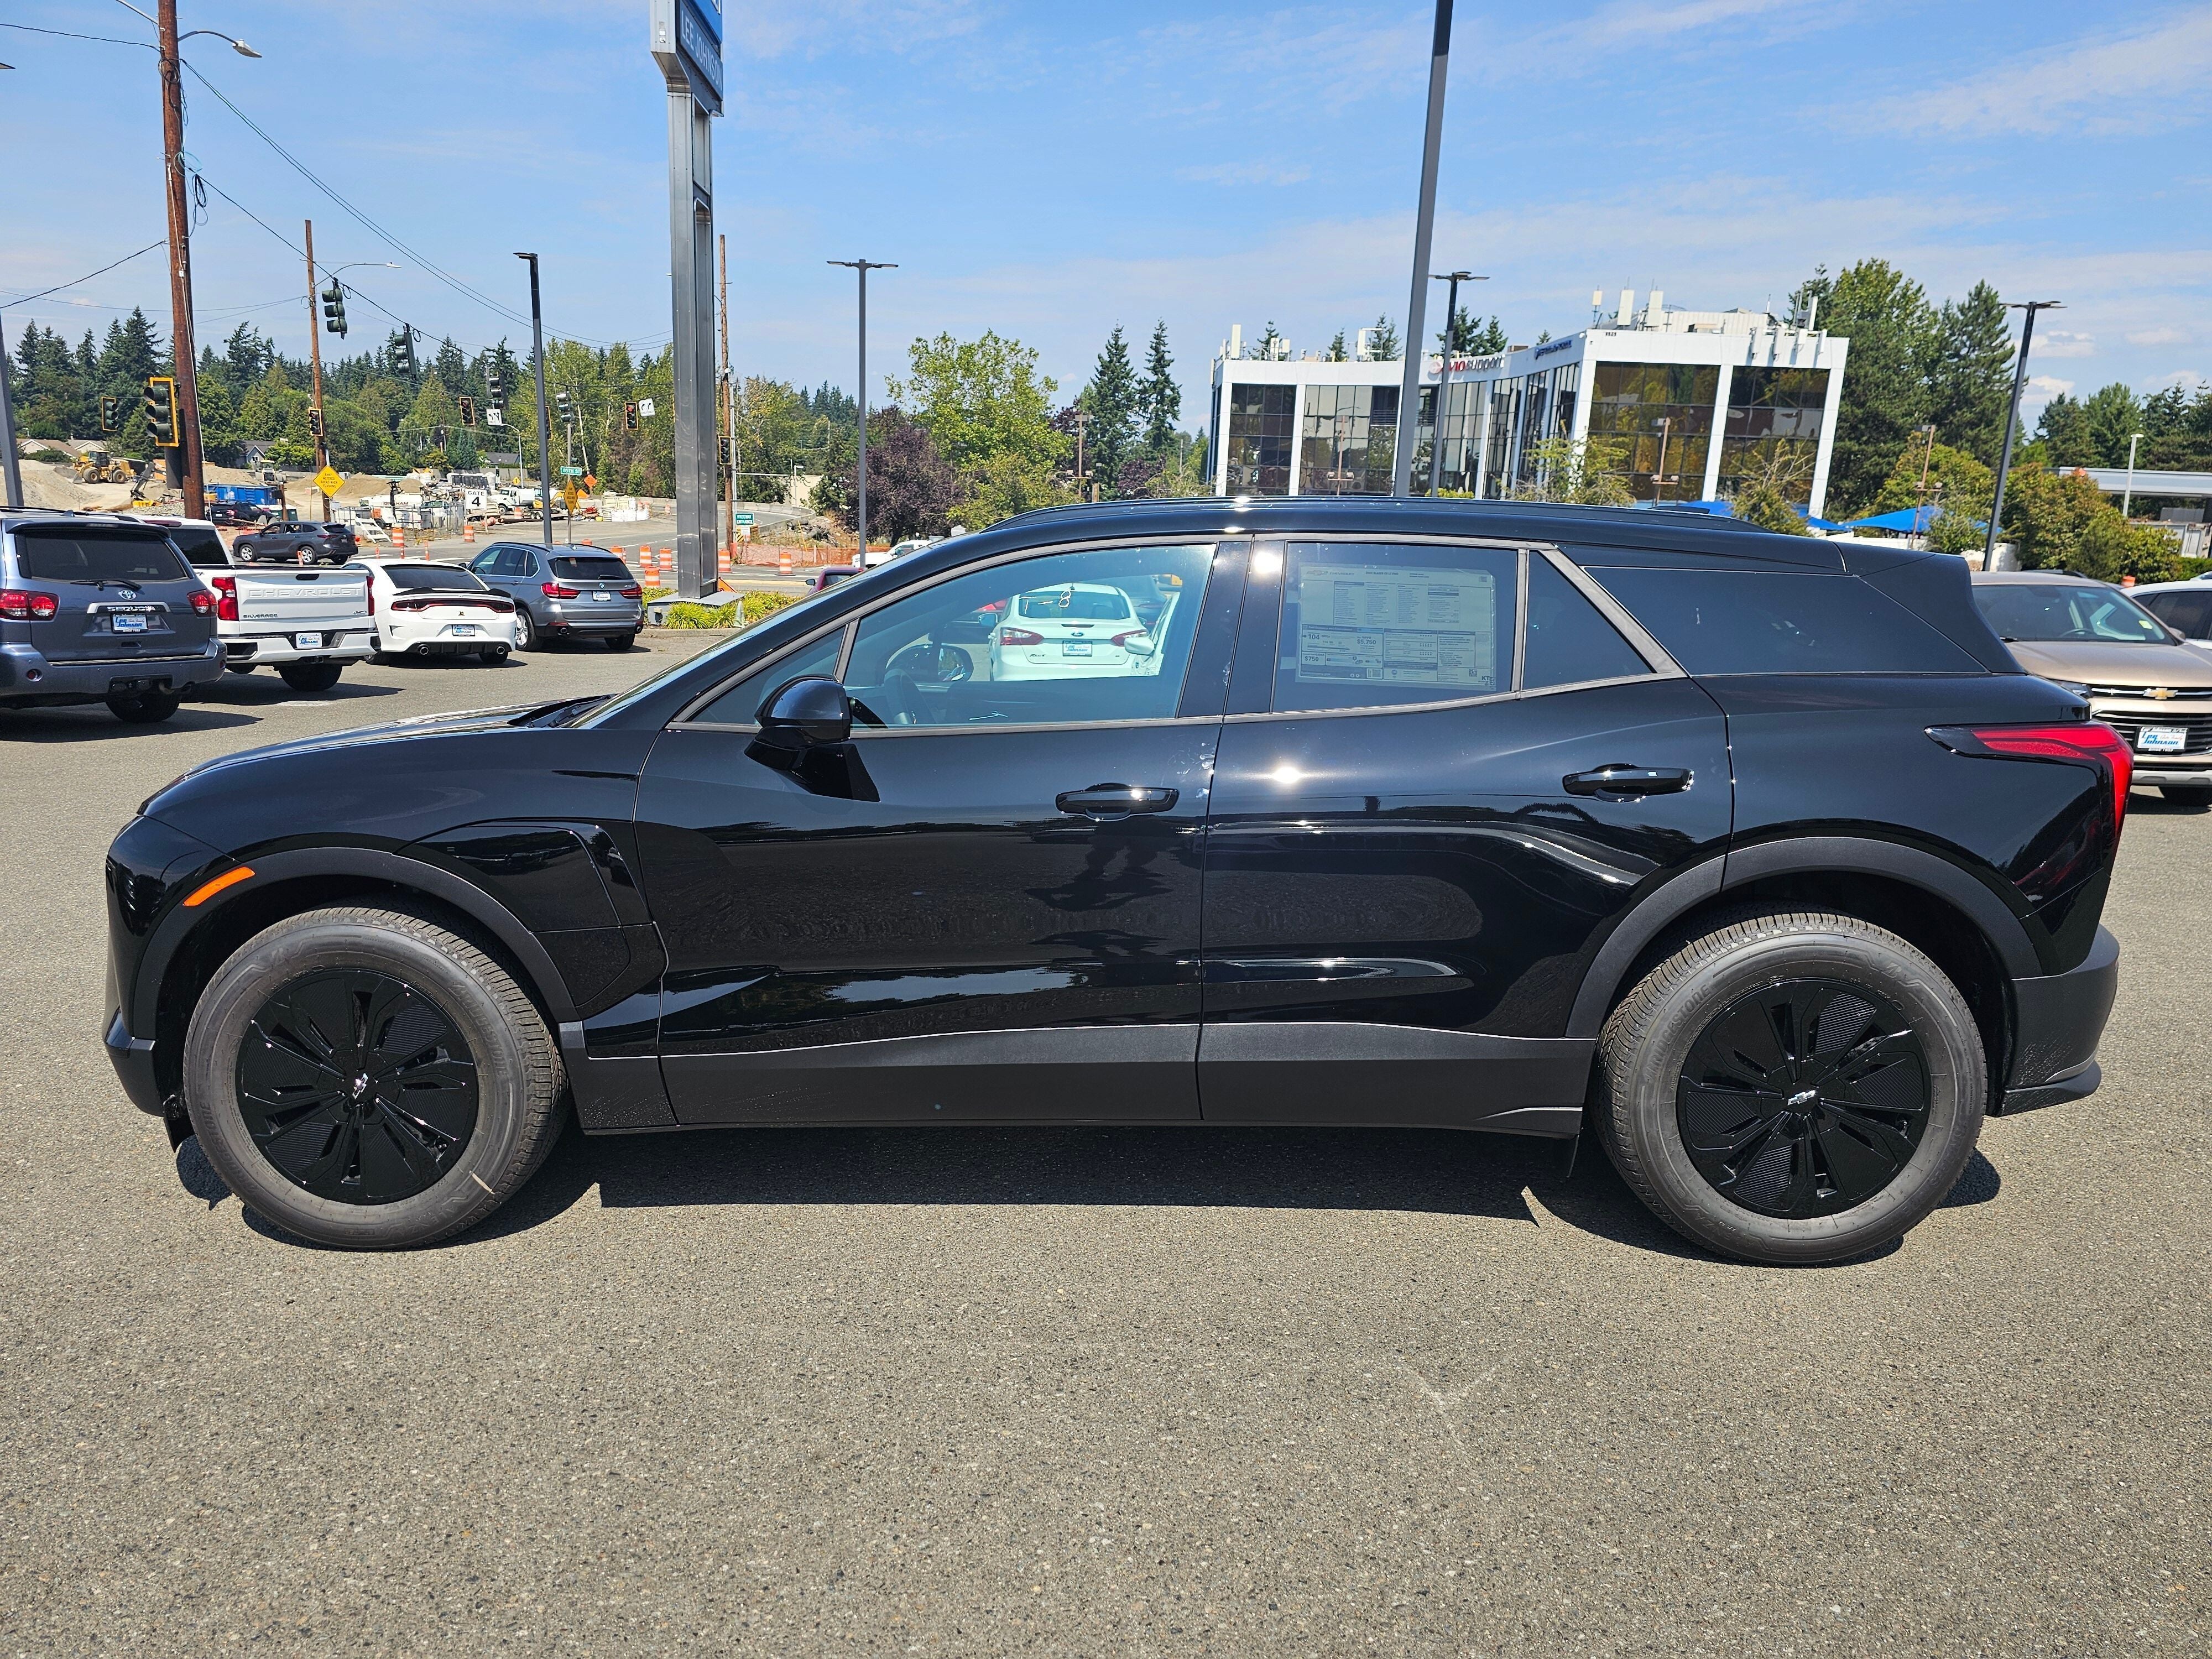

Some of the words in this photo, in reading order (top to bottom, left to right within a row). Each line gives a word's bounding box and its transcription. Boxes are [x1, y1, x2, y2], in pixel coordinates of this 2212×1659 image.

[681, 10, 694, 51] LEE
[695, 32, 723, 91] JOHNSON
[472, 497, 481, 507] 4
[248, 587, 362, 598] CHEVROLET
[2142, 731, 2158, 739] Lee
[2143, 737, 2178, 745] Johnson
